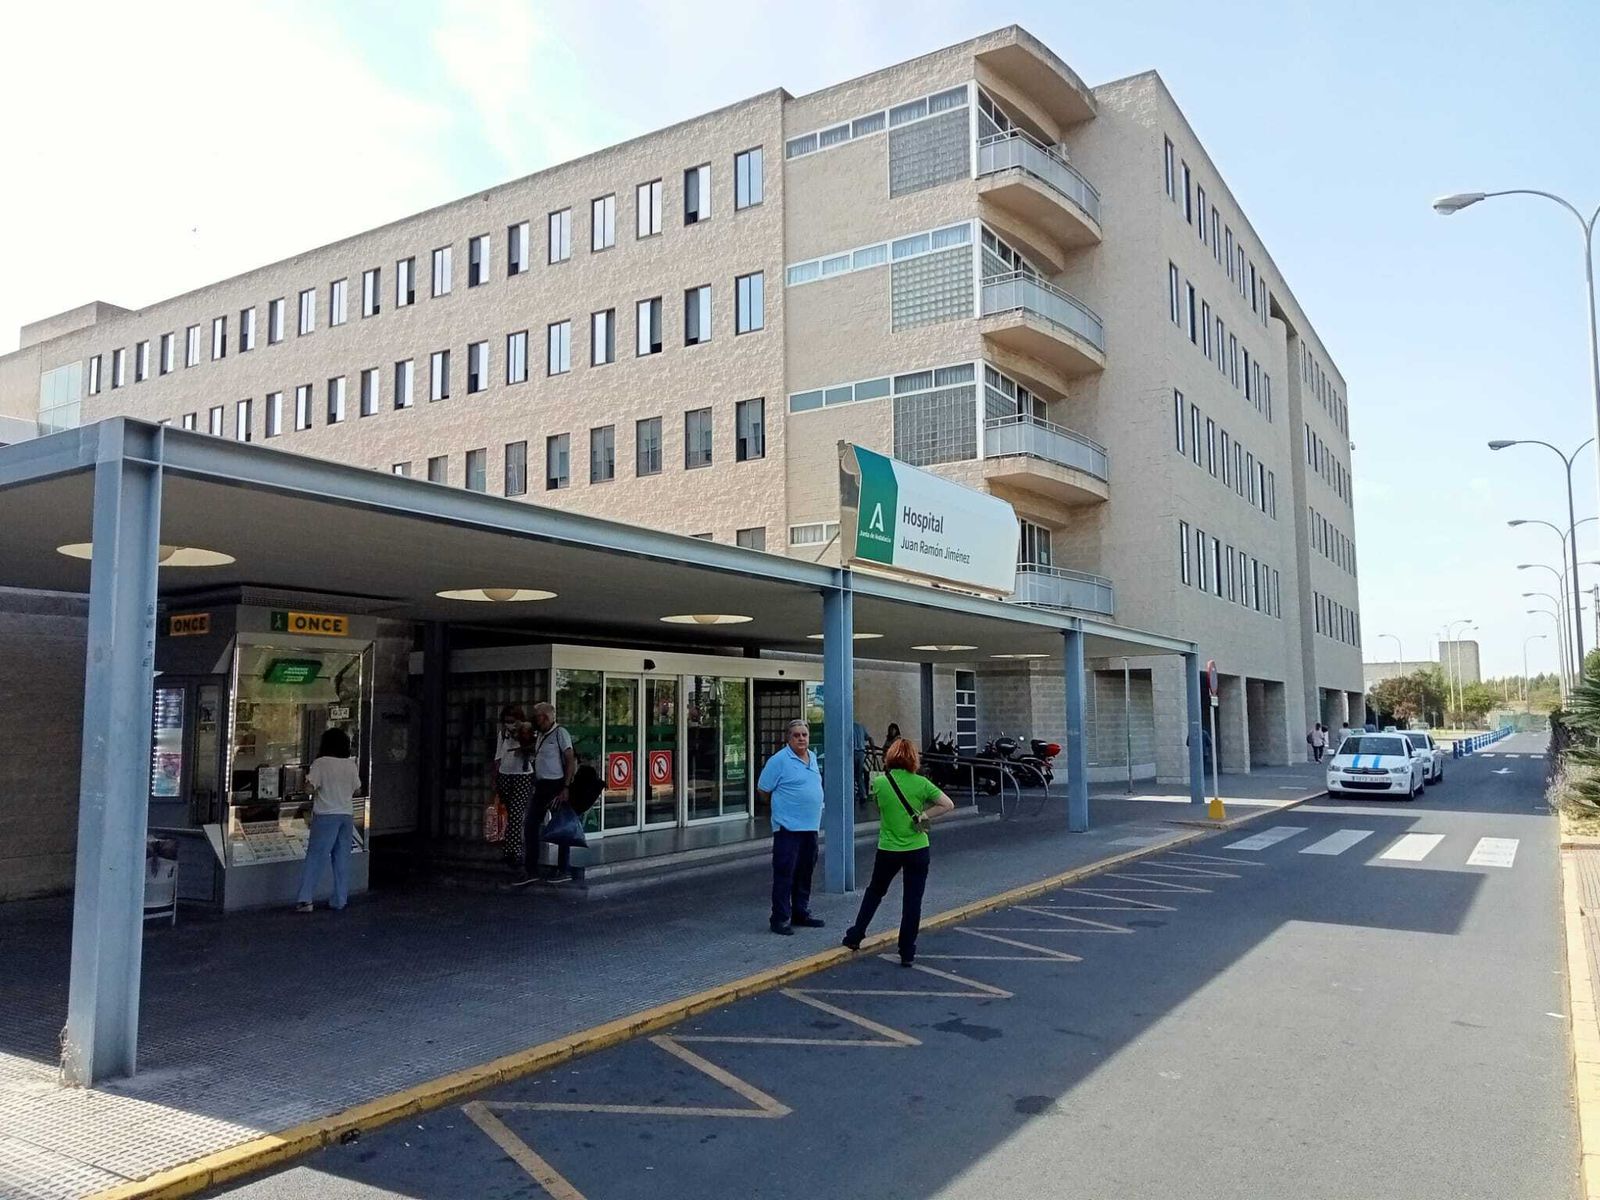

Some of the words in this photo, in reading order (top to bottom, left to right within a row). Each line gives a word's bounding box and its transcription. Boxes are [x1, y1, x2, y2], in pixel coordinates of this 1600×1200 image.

[903, 505, 944, 534] Hospital
[901, 536, 919, 551] Juan
[920, 540, 943, 558] Ramón
[944, 546, 970, 565] Jiménez
[173, 616, 206, 632] ONCE
[295, 617, 343, 632] ONCE
